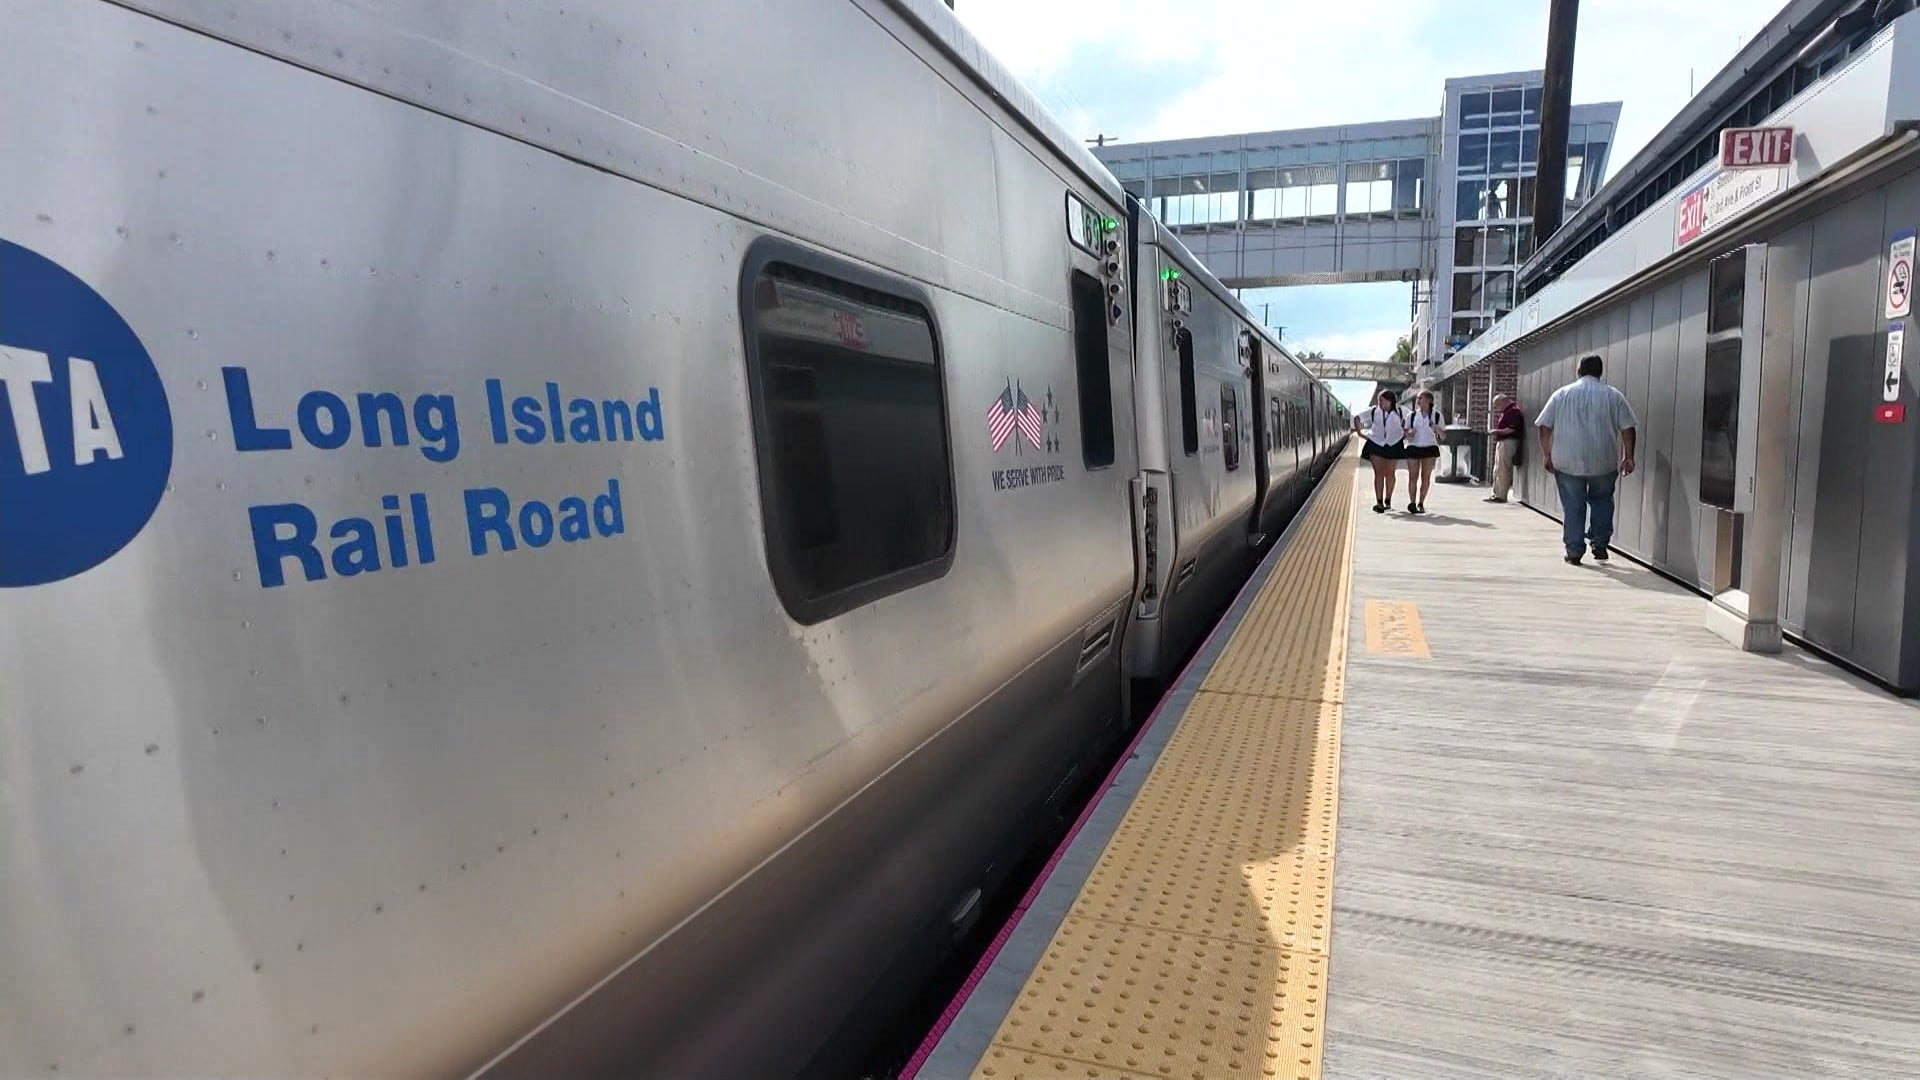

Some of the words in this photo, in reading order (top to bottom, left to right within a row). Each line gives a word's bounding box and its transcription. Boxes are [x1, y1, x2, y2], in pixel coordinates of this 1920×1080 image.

[1733, 130, 1786, 164] EXIT
[222, 366, 460, 463] Long
[486, 378, 665, 444] Island
[992, 470, 1005, 492] WE
[1006, 468, 1029, 489] SERVE
[1029, 465, 1047, 485] WITH
[1047, 464, 1064, 483] PRIDE
[249, 492, 435, 589] Rail
[463, 478, 624, 556] Road
